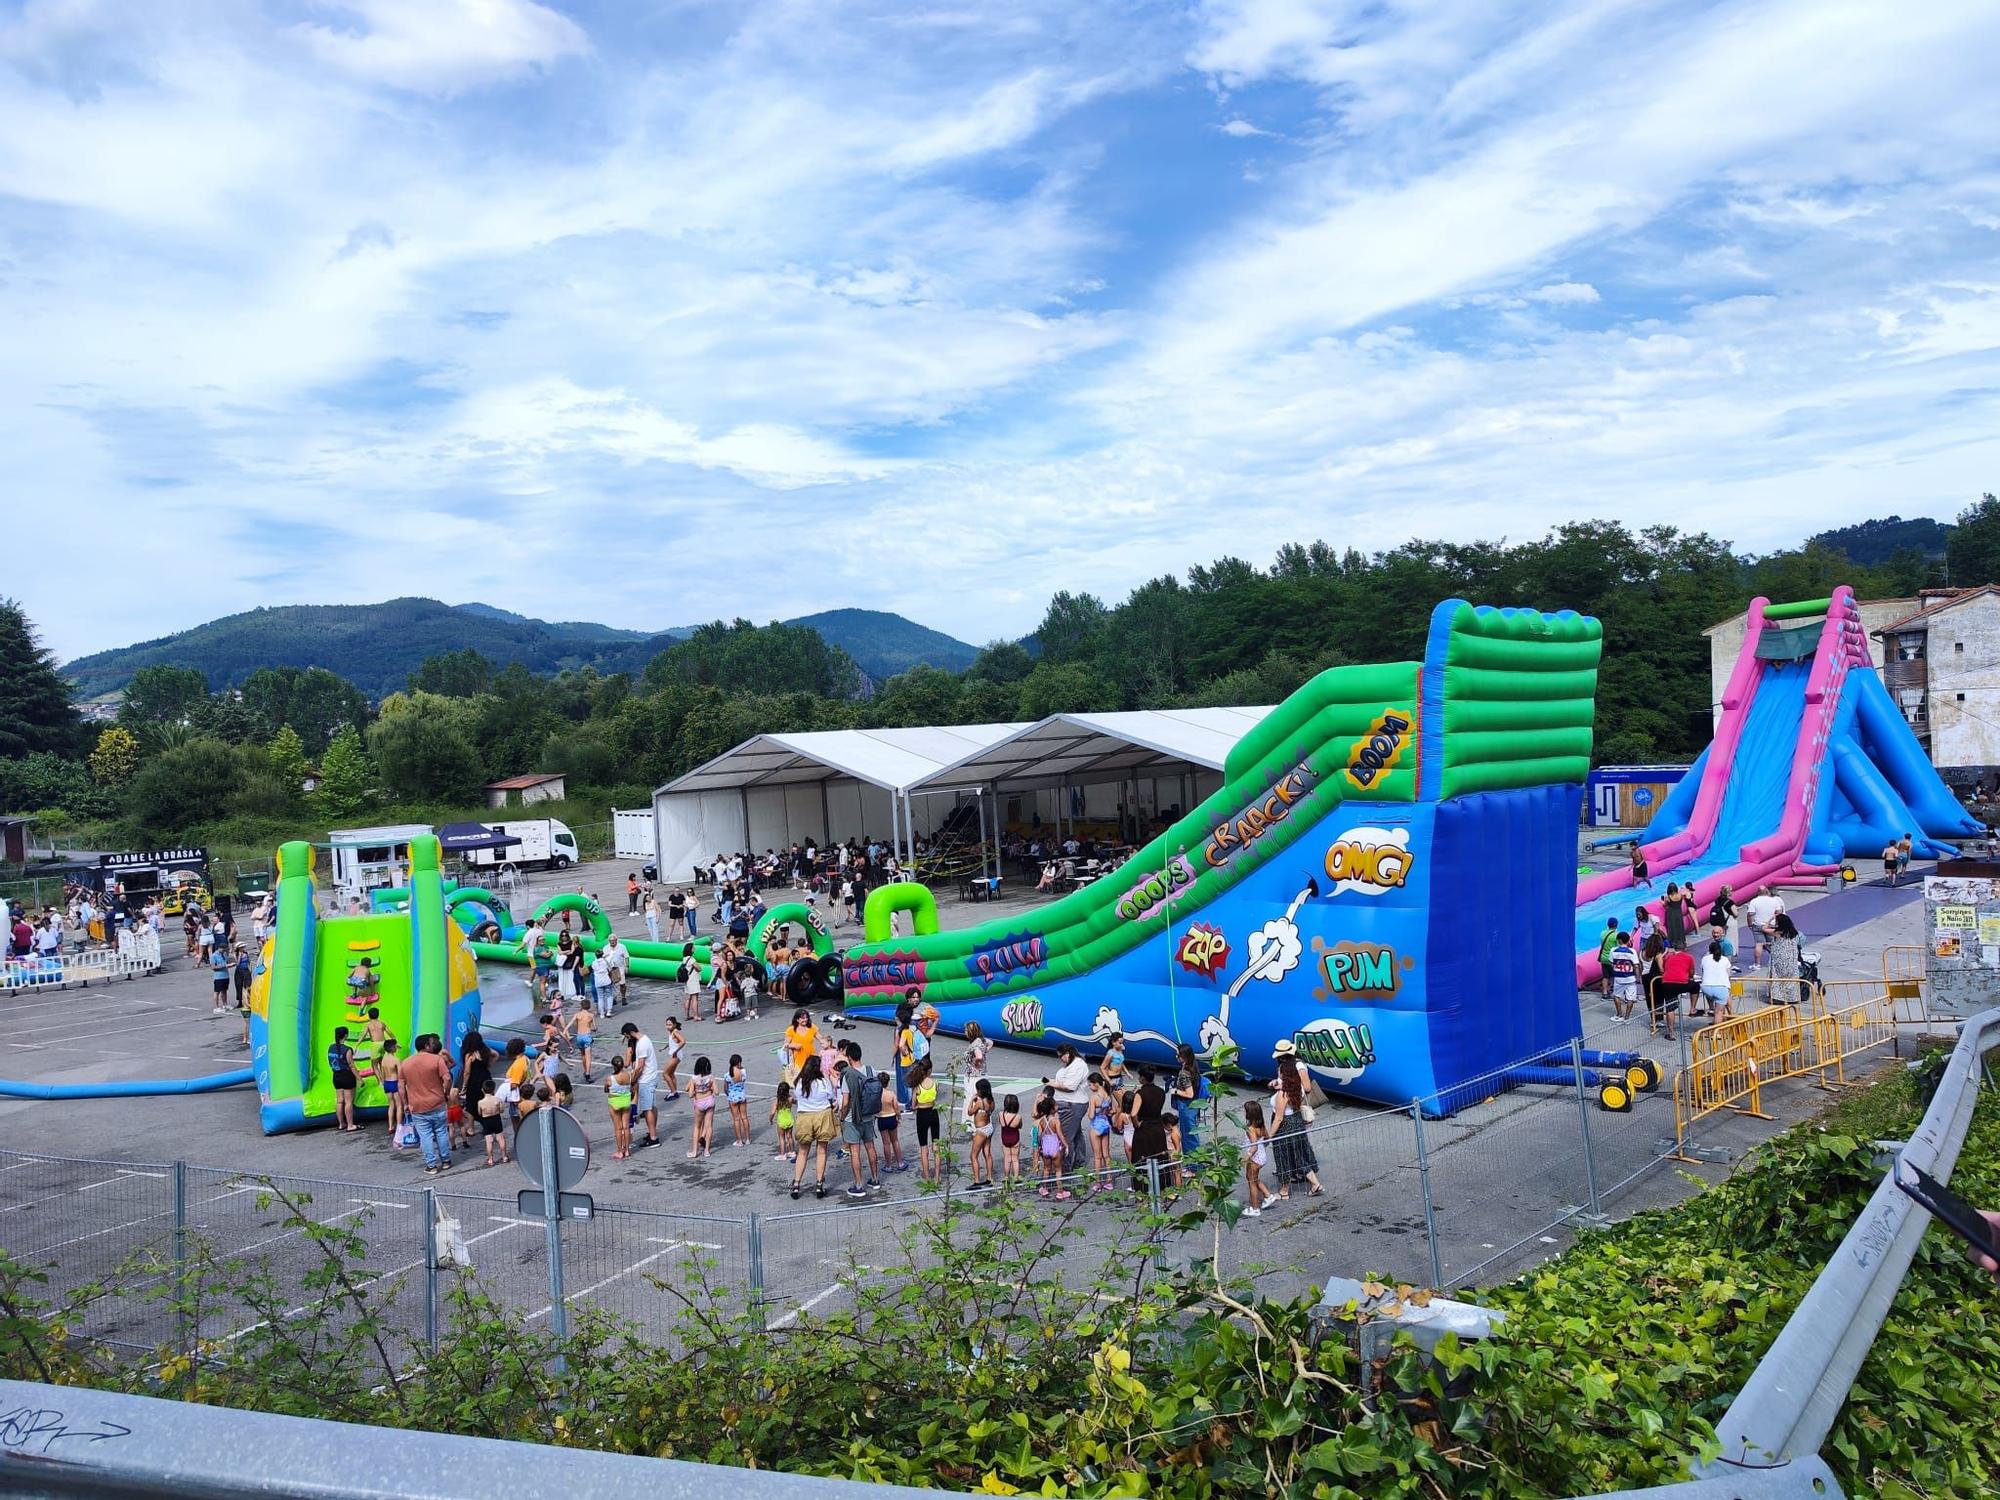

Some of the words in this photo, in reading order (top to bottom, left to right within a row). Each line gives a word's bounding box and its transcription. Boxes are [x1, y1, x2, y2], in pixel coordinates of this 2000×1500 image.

[1349, 714, 1409, 787] BOOM
[116, 853, 146, 864] DAME
[148, 853, 161, 861] LA
[163, 849, 194, 860] BRASA
[1324, 840, 1415, 888] OMG!
[585, 900, 600, 916] UP
[1120, 860, 1190, 920] OOOPS
[977, 937, 1041, 982] POW
[1182, 924, 1228, 971] ZAP
[846, 958, 918, 986] CRASH
[1323, 950, 1395, 993] PUM
